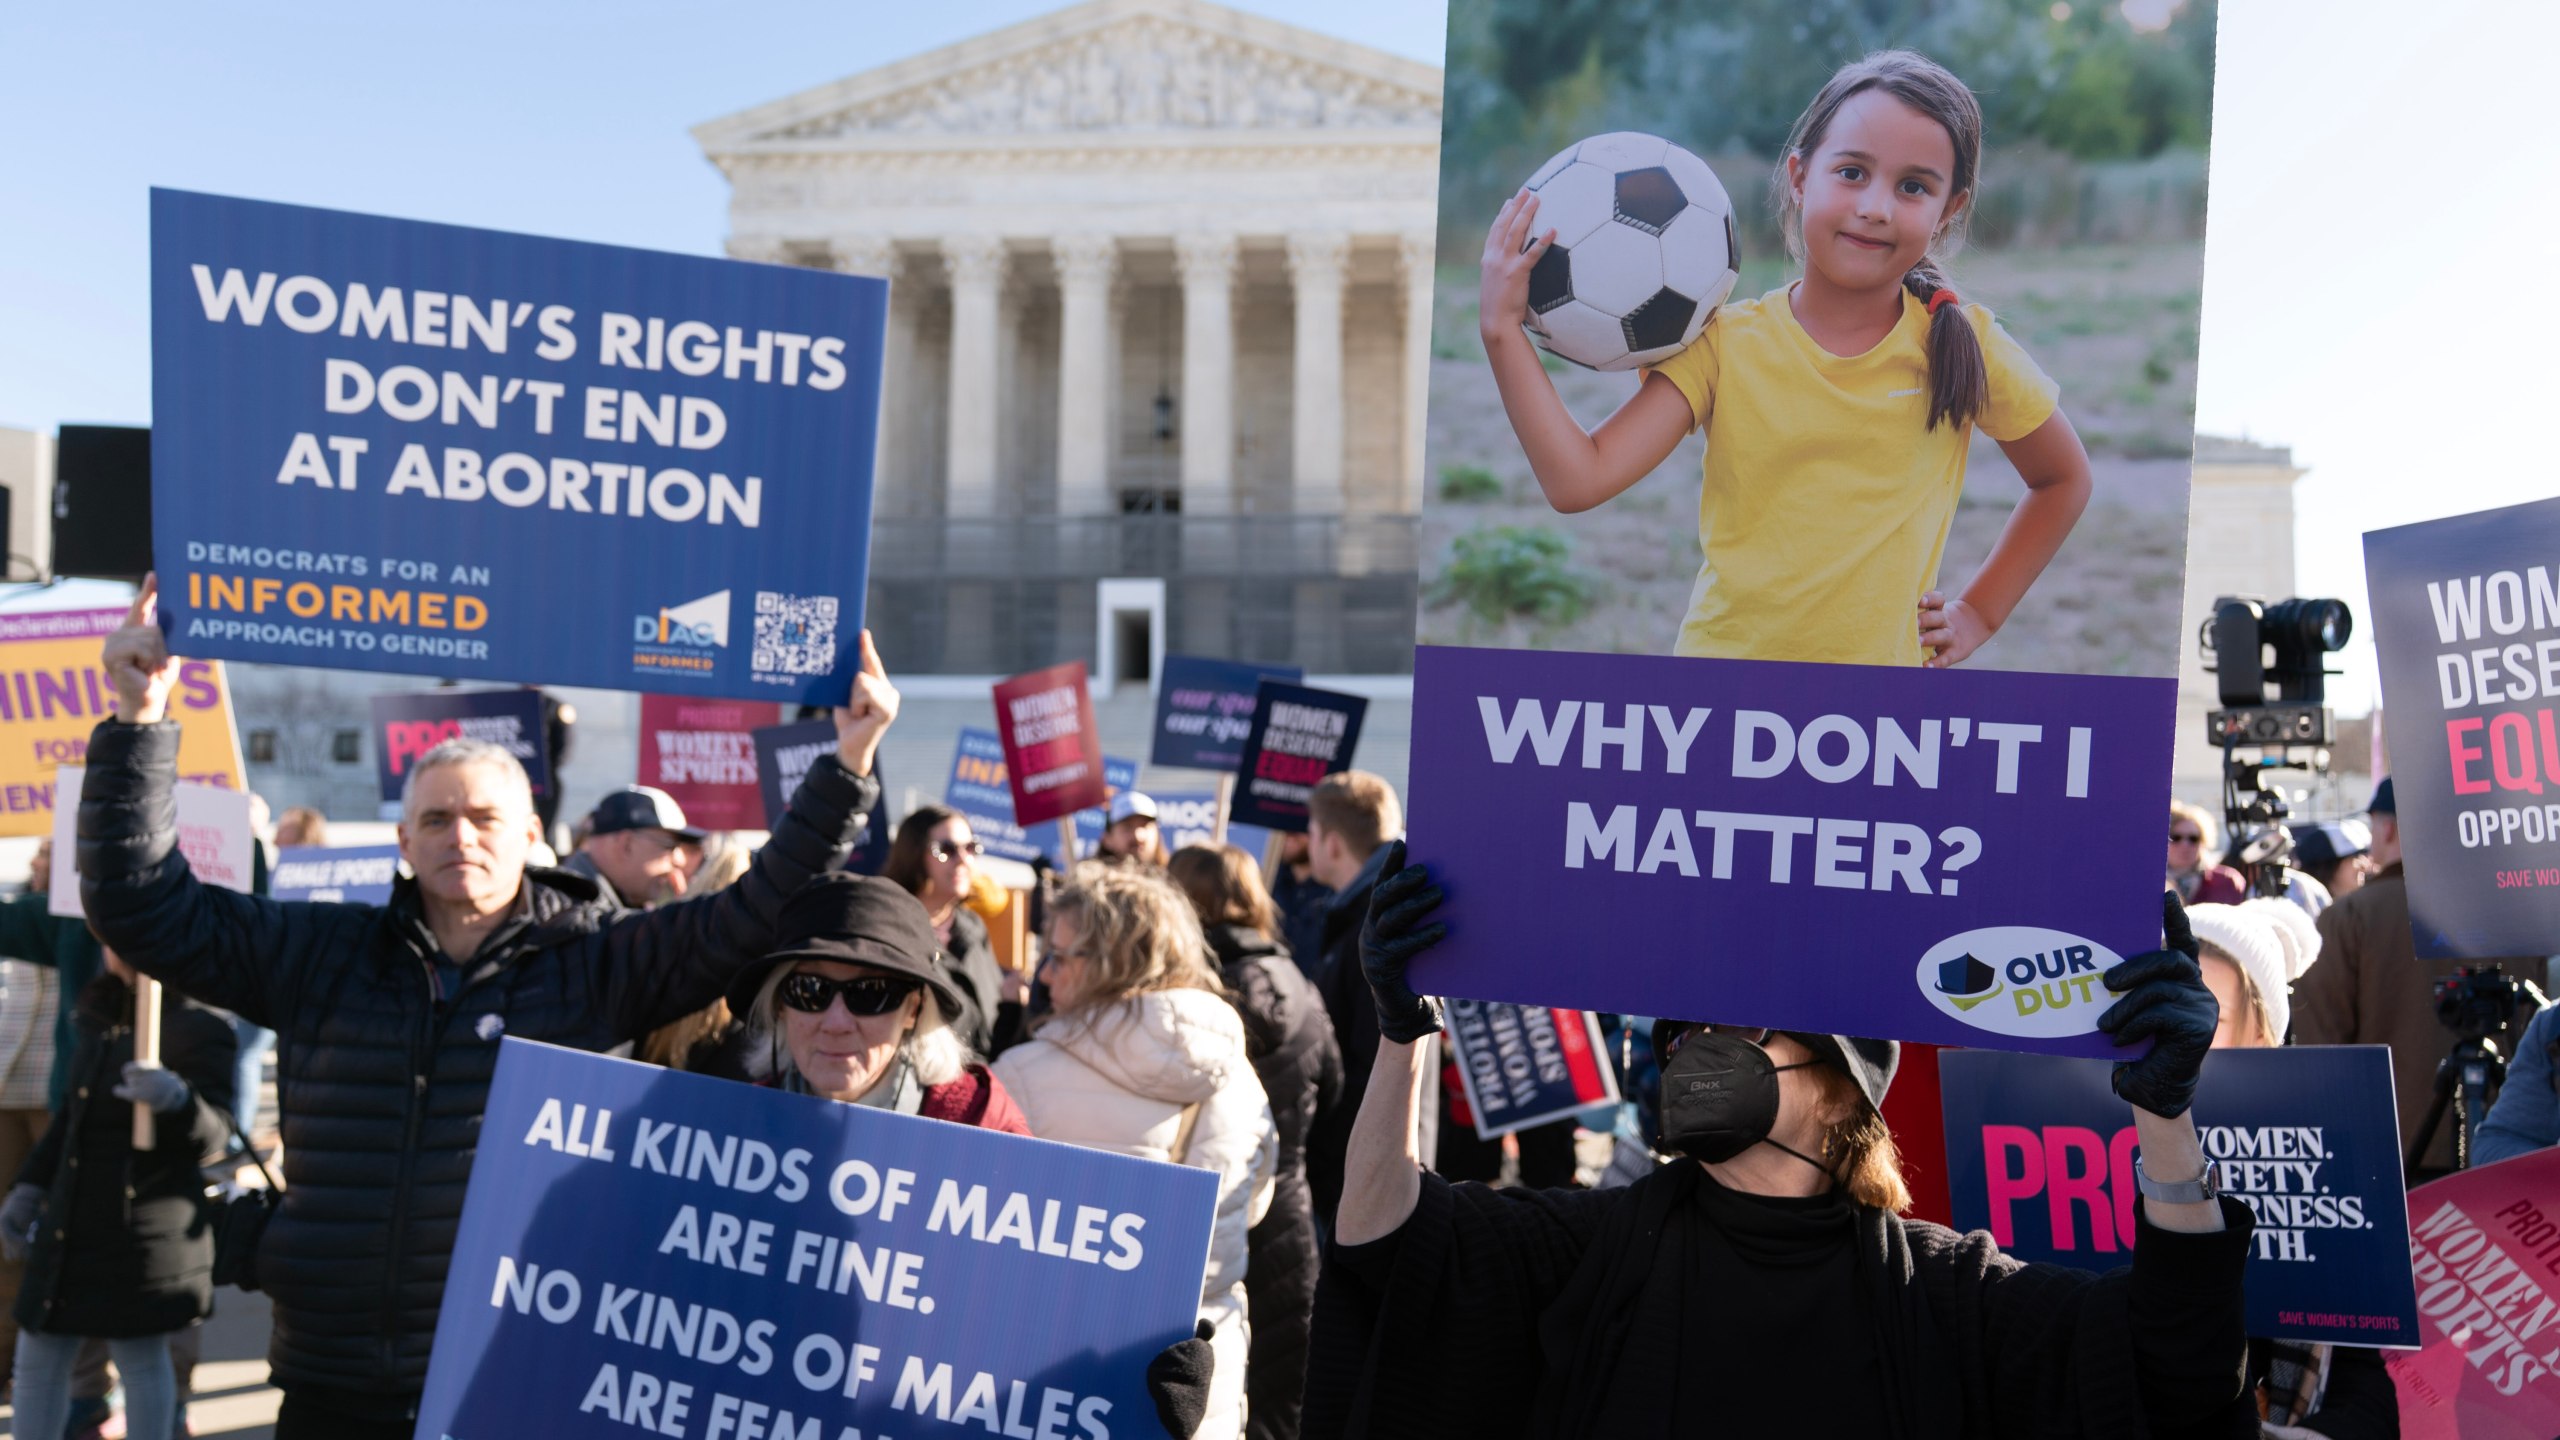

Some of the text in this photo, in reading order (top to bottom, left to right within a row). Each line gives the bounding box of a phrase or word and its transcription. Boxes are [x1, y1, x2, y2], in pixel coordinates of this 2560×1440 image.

[191, 263, 847, 391] WOMEN'S RIGHTS
[325, 358, 727, 450] DON'T END
[277, 432, 762, 528] AT ABORTION
[187, 541, 490, 586] DEMOCRATS FOR AN
[188, 573, 488, 631] INFORMED
[188, 618, 488, 660] APPROACH TO GENDER
[634, 607, 715, 648] DIAG
[633, 654, 714, 671] INFORMED
[1009, 685, 1078, 723] WOMEN
[1270, 700, 1349, 738] WOMEN
[1261, 727, 1339, 762] DESERVE
[1476, 696, 2092, 799] WHY DON'T I
[659, 757, 758, 784] SPORTS
[1254, 748, 1329, 787] EQUAL
[1564, 802, 1983, 897] MATTER?
[2496, 868, 2532, 889] SAVE
[2006, 944, 2098, 986] OUR
[524, 1097, 1148, 1272] ALL KINDS OF MALES
[2216, 1160, 2330, 1194] FETY.
[2241, 1194, 2374, 1230] RNESS.
[657, 1204, 936, 1316] ARE FINE.
[2278, 1310, 2401, 1331] SAVE WOMEN'S SPORTS
[490, 1255, 1115, 1440] NO KINDS OF MALES
[579, 1362, 695, 1440] ARE
